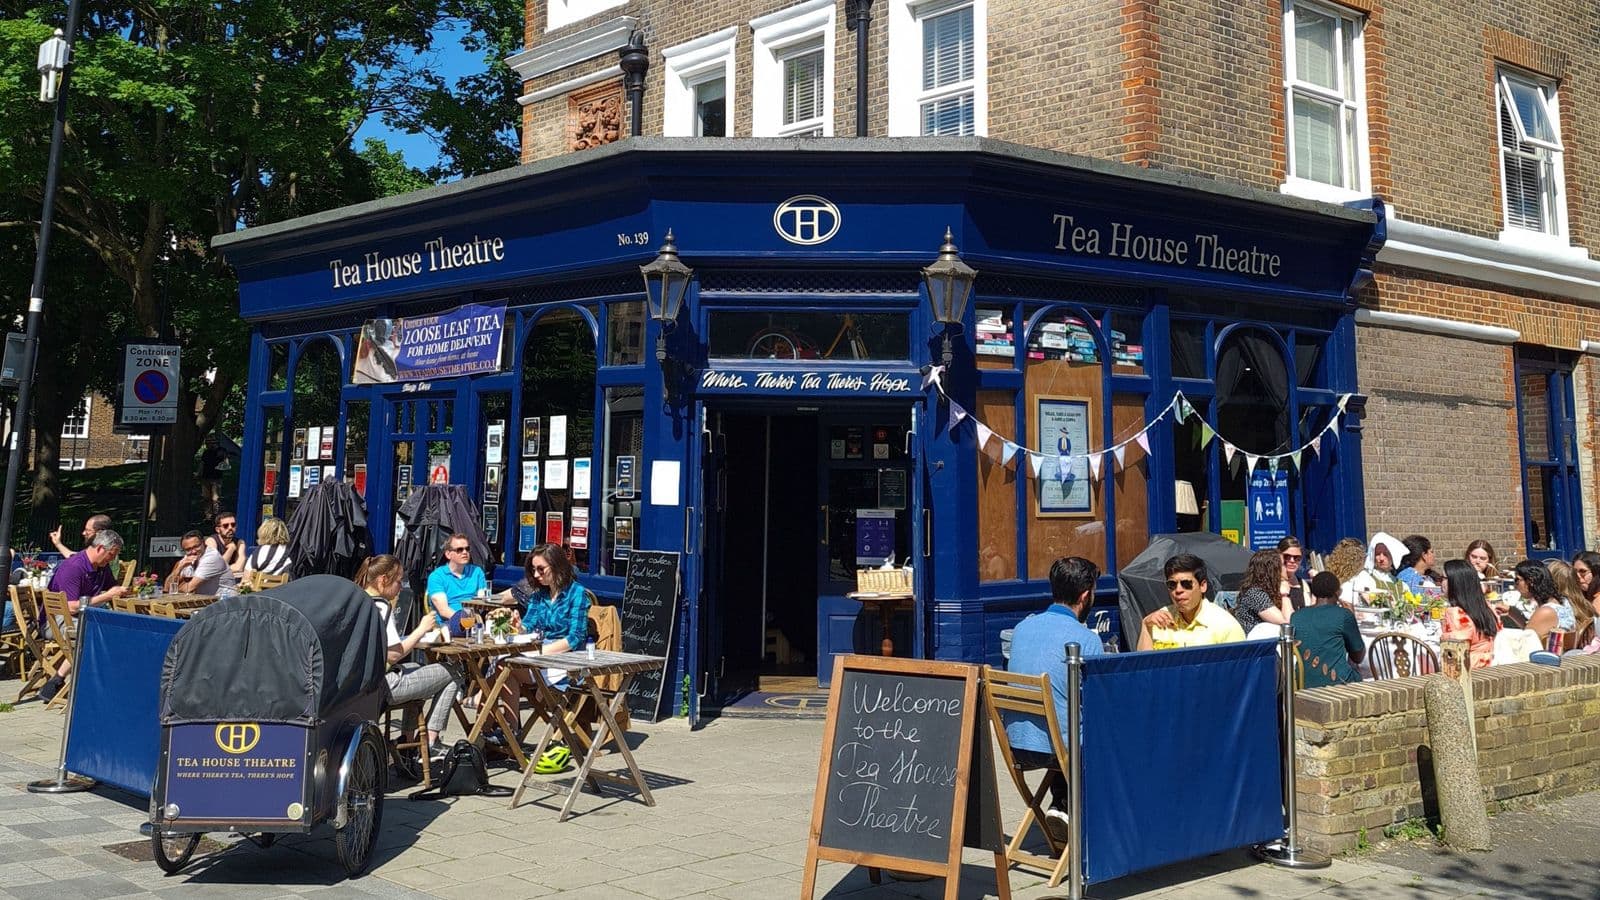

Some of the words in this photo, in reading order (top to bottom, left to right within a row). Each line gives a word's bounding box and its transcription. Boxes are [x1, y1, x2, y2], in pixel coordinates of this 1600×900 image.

[617, 233, 633, 246] No.
[634, 232, 649, 245] 139
[1053, 214, 1100, 254] Tea
[1108, 222, 1188, 265] House
[1195, 234, 1281, 277] Theatre
[329, 259, 362, 288] Tea
[364, 251, 422, 282] House
[425, 235, 505, 272] Theatre
[404, 325, 442, 345] LOOSE
[444, 318, 471, 338] LEAF
[474, 313, 500, 333] TEA
[130, 348, 177, 356] Controlled
[407, 346, 425, 358] FOR
[425, 342, 450, 356] HOME
[450, 333, 493, 352] DELIVERY
[136, 358, 169, 368] ZONE
[702, 371, 748, 389] Where
[800, 372, 821, 390] Tea
[869, 373, 912, 394] Hope
[152, 544, 178, 553] LAUD
[853, 681, 961, 716] Welcome
[853, 718, 875, 740] to
[876, 718, 921, 743] the
[176, 758, 199, 768] TEA
[202, 758, 241, 768] HOUSE
[244, 758, 296, 768] THEATRE
[837, 742, 881, 781] Tea
[889, 749, 959, 788] House
[231, 772, 246, 780] TEA,
[838, 781, 943, 839] Theatre
